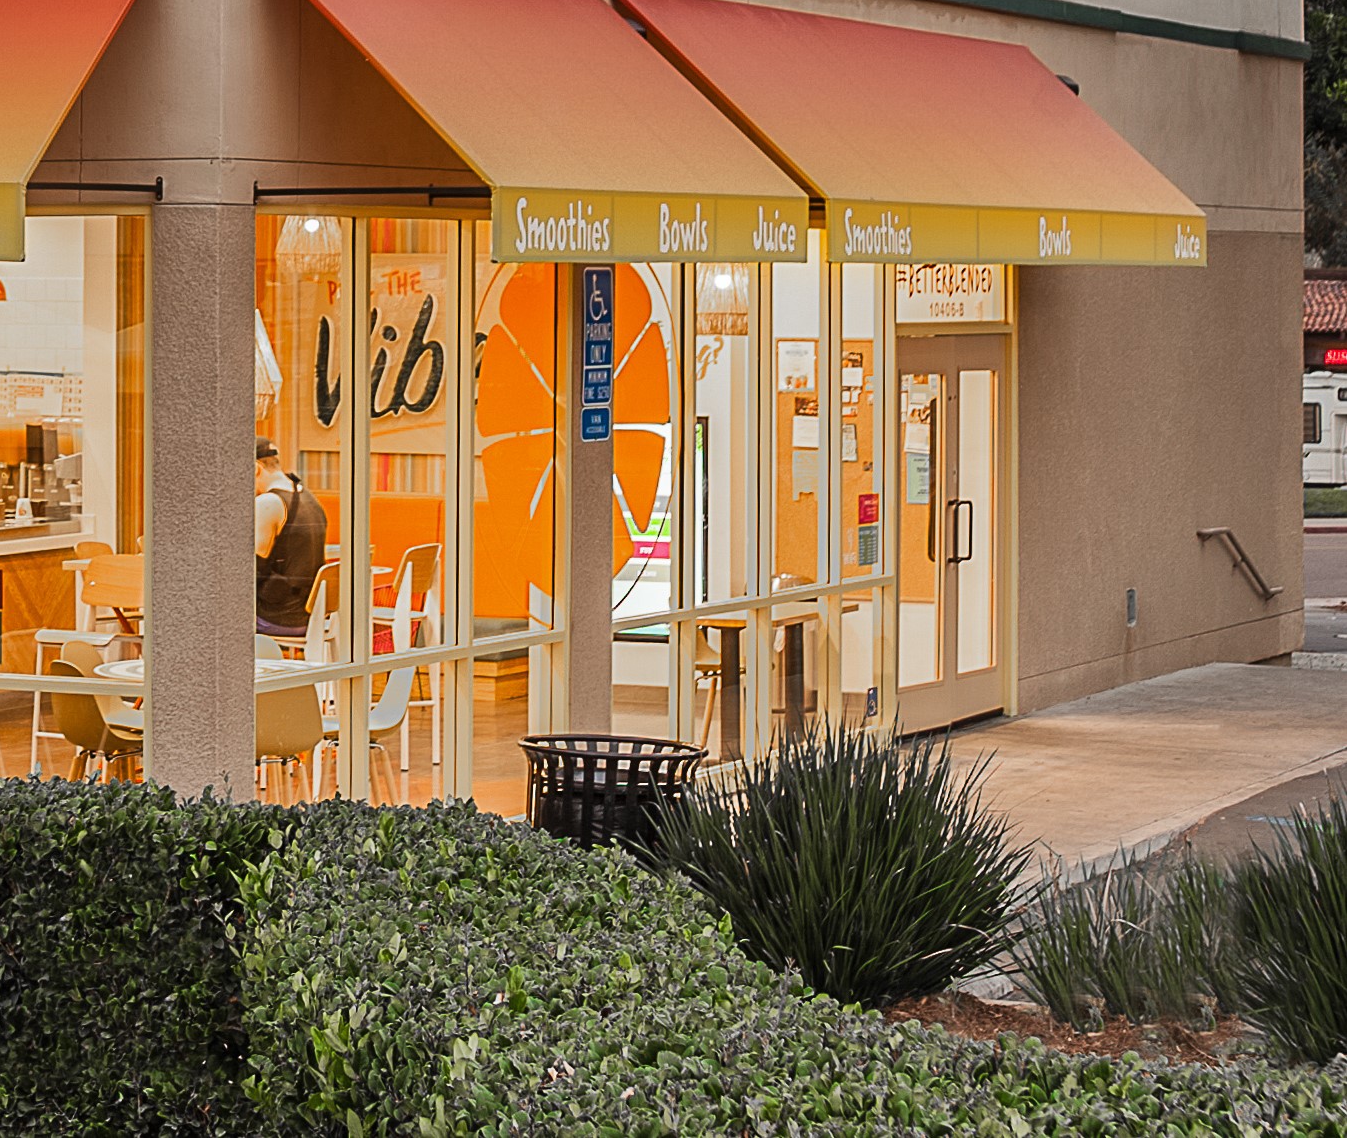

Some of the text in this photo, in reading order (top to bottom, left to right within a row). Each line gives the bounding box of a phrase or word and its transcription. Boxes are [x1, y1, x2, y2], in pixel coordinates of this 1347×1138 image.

[514, 197, 797, 254] Smoothies Bowls Juice
[843, 207, 1201, 260] Smoothies Bowls Juice
[381, 269, 423, 296] THE
[897, 263, 993, 298] #BETTERBLENDED
[929, 302, 965, 318] 10406-B
[586, 322, 612, 342] PARKING
[589, 344, 608, 364] ONLY
